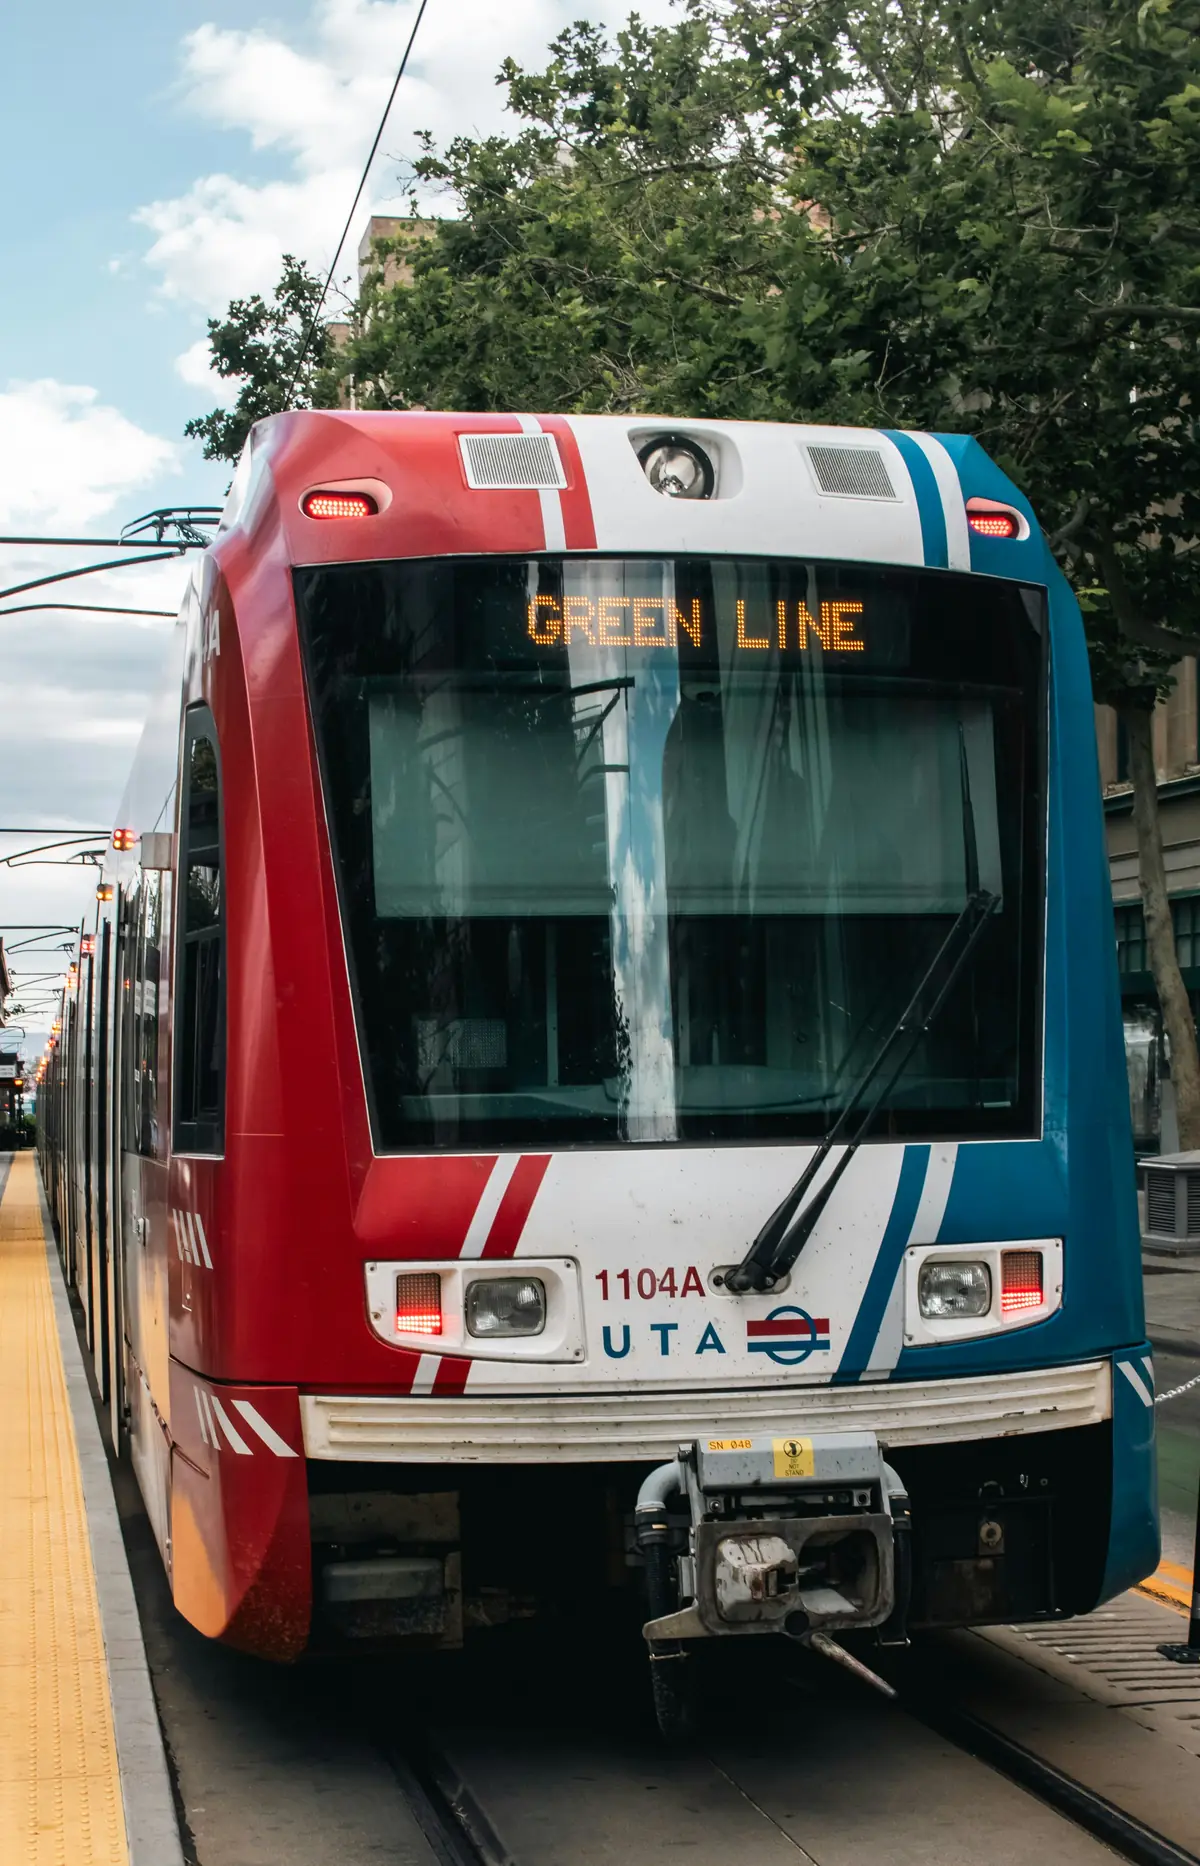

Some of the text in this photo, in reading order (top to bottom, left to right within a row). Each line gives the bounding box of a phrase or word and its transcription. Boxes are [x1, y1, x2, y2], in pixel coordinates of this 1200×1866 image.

[528, 595, 864, 650] GREEN LINE
[595, 1266, 706, 1300] 1104A
[602, 1321, 726, 1359] UTA
[709, 1439, 752, 1450] SN 048
